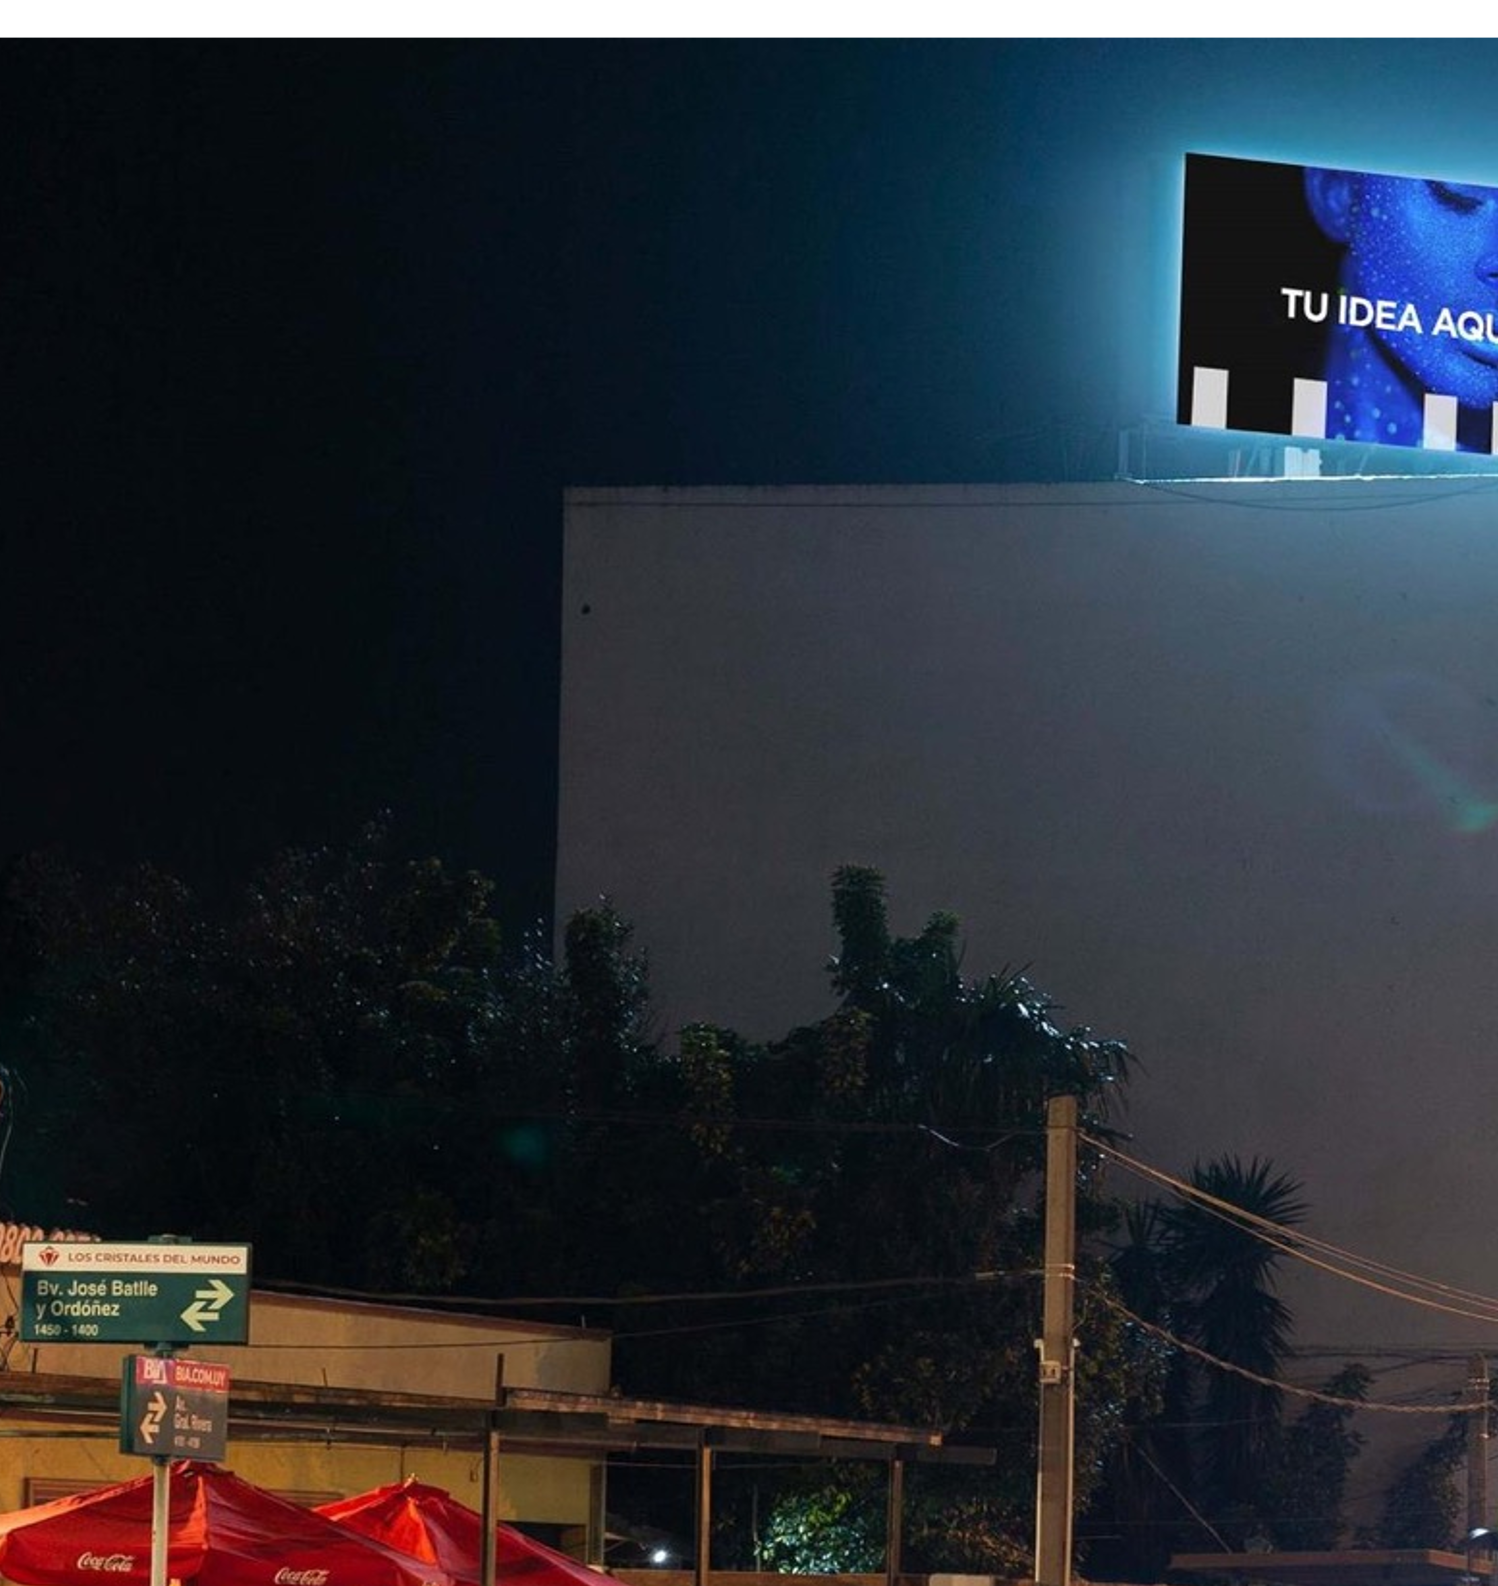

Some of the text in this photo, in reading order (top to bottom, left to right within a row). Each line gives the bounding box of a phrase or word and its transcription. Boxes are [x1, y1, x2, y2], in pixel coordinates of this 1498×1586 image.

[1281, 287, 1329, 323] TU
[1339, 294, 1423, 335] IDEA
[68, 1252, 241, 1265] LOS CRISTALES DEL MUNDO
[37, 1279, 158, 1297] Bv. José Batlle
[36, 1300, 120, 1319] y Ordóñez
[34, 1323, 62, 1336] 1450
[72, 1323, 99, 1336] 1400
